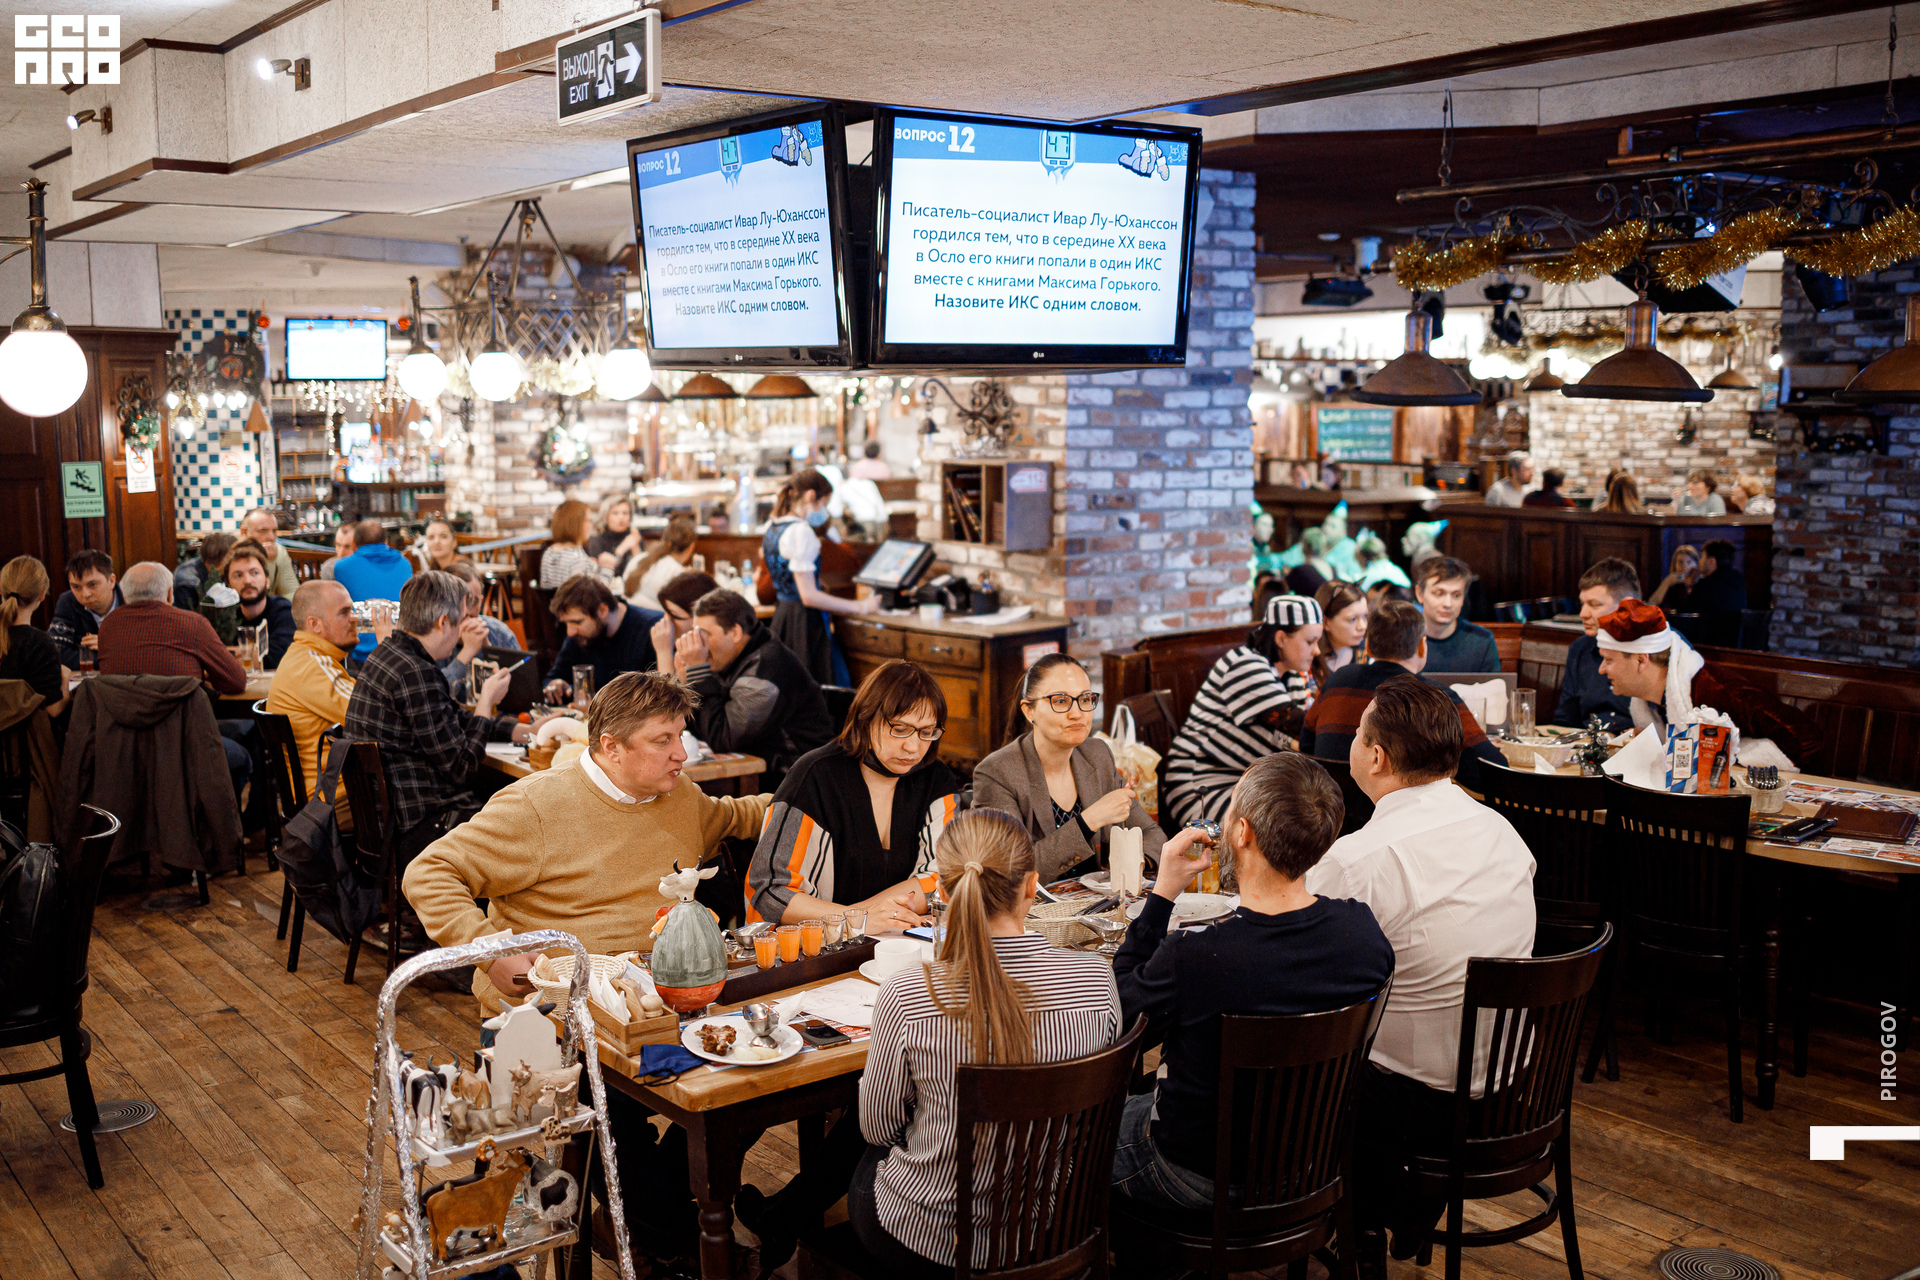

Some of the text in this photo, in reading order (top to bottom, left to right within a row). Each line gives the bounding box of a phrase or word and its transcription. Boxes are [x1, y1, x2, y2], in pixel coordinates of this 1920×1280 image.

[563, 50, 596, 81] ВЫХОД
[569, 82, 589, 104] EXIT
[895, 125, 976, 153] ВОПРОС 12
[638, 151, 682, 176] ВОПРОС 12
[649, 208, 825, 238] Писатель-социалист Ивар Лу-Юханссон
[902, 202, 1177, 230] Писатель-социалист Ивар Лу-Юханссон
[657, 244, 694, 259] гордился
[696, 242, 712, 254] тем,
[714, 241, 728, 251] что
[731, 240, 735, 249] в
[738, 236, 780, 251] середине
[798, 232, 819, 243] века
[913, 229, 980, 243] гордился
[985, 232, 1012, 246] тем,
[1016, 234, 1038, 244] что
[1043, 236, 1049, 244] в
[1053, 235, 1114, 249] середине
[1139, 240, 1166, 250] века
[661, 251, 818, 276] в Осло его книги попали в один ИКС
[916, 249, 1162, 270] в Осло его книги попали в один ИКС
[663, 276, 821, 296] вместе с книгами Максима Горького.
[914, 274, 1161, 292] вместе с книгами Максима Горького.
[676, 300, 808, 315] Назовите ИКС одним словом.
[935, 294, 1141, 311] Назовите ИКС одним словом.
